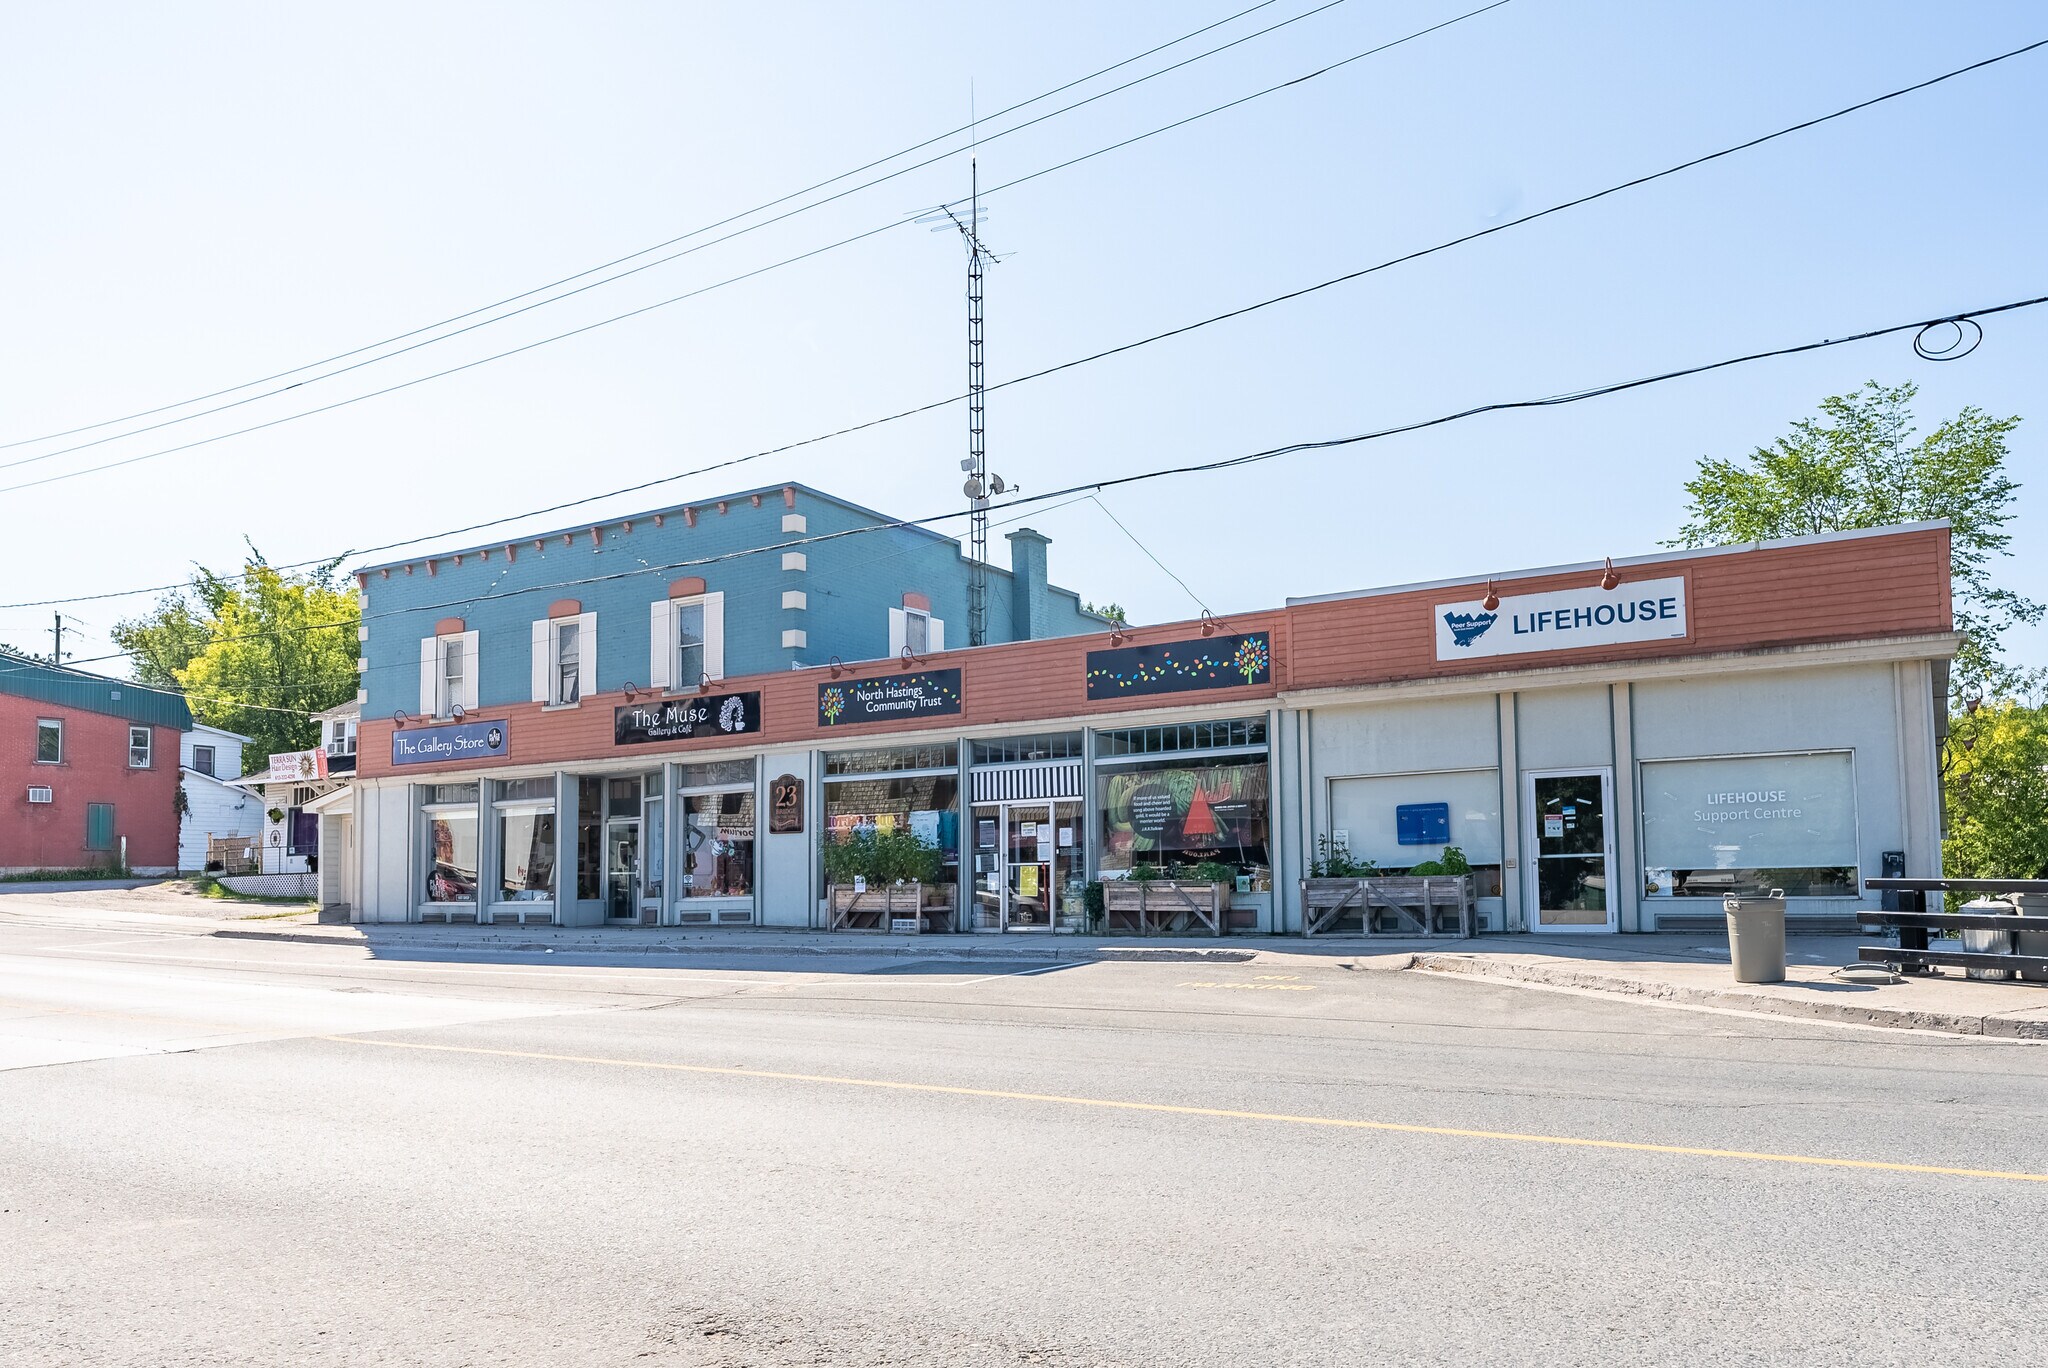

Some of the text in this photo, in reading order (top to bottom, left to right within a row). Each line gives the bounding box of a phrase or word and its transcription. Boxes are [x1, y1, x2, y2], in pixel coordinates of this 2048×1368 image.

[1466, 619, 1492, 628] Support
[1512, 597, 1678, 635] LIFEHOUSE
[856, 686, 923, 702] North Hastings
[865, 695, 942, 712] Community Trust
[632, 706, 708, 728] The Muse
[648, 726, 671, 737] Gallery
[397, 735, 485, 757] The Gallery Store
[271, 754, 297, 764] TERRA SUN
[271, 763, 298, 774] Hair Design
[775, 785, 797, 807] 23
[1707, 790, 1787, 805] LIFEHOUSE
[1694, 807, 1802, 824] Support Centre
